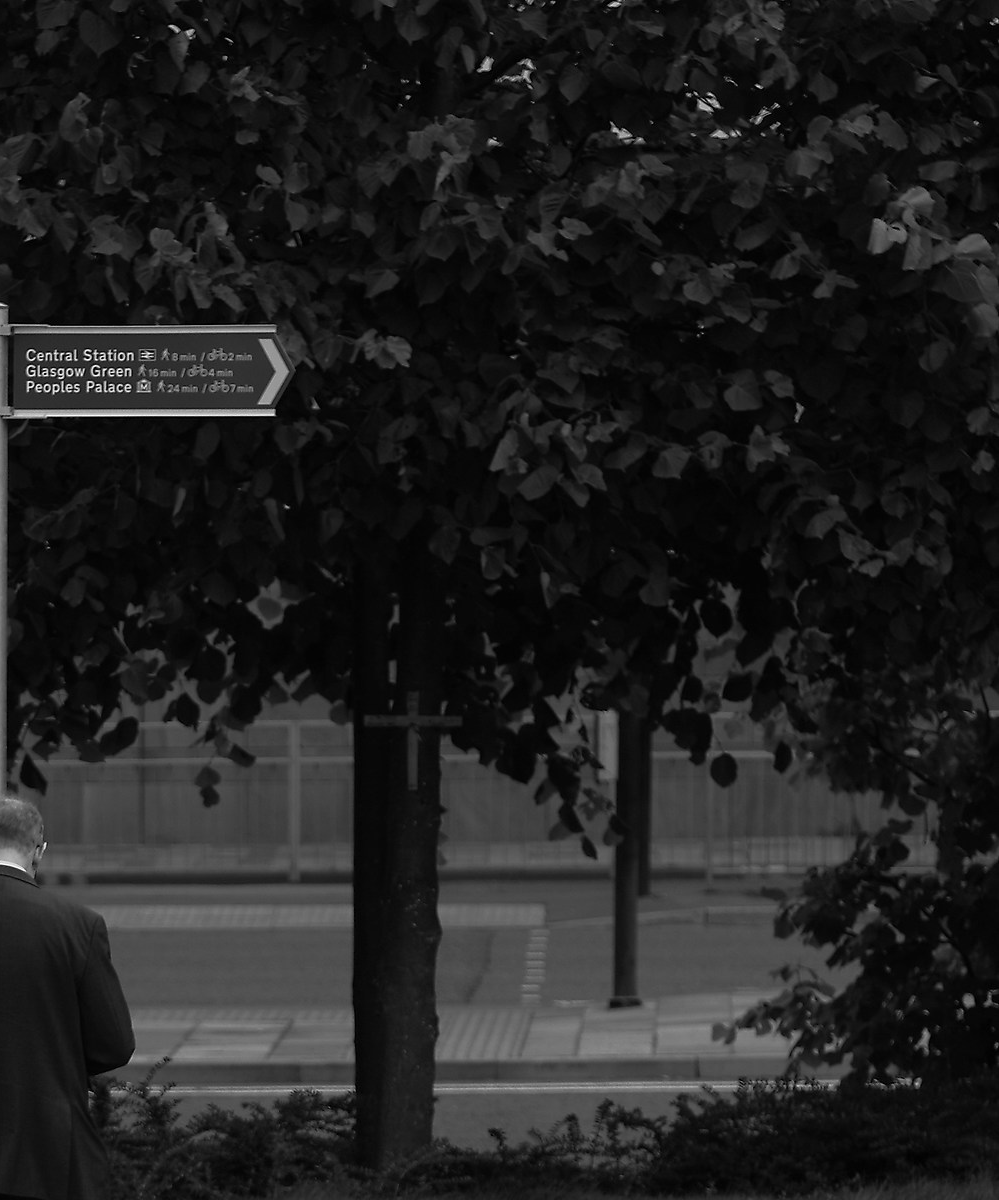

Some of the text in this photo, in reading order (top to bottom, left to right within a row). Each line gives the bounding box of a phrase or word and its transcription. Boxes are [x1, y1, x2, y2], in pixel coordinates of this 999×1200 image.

[26, 348, 78, 362] Central
[83, 348, 135, 362] Station
[26, 364, 86, 380] Glasgow
[90, 364, 132, 378] Green
[26, 380, 81, 396] Peoples
[86, 380, 132, 393] Palace
